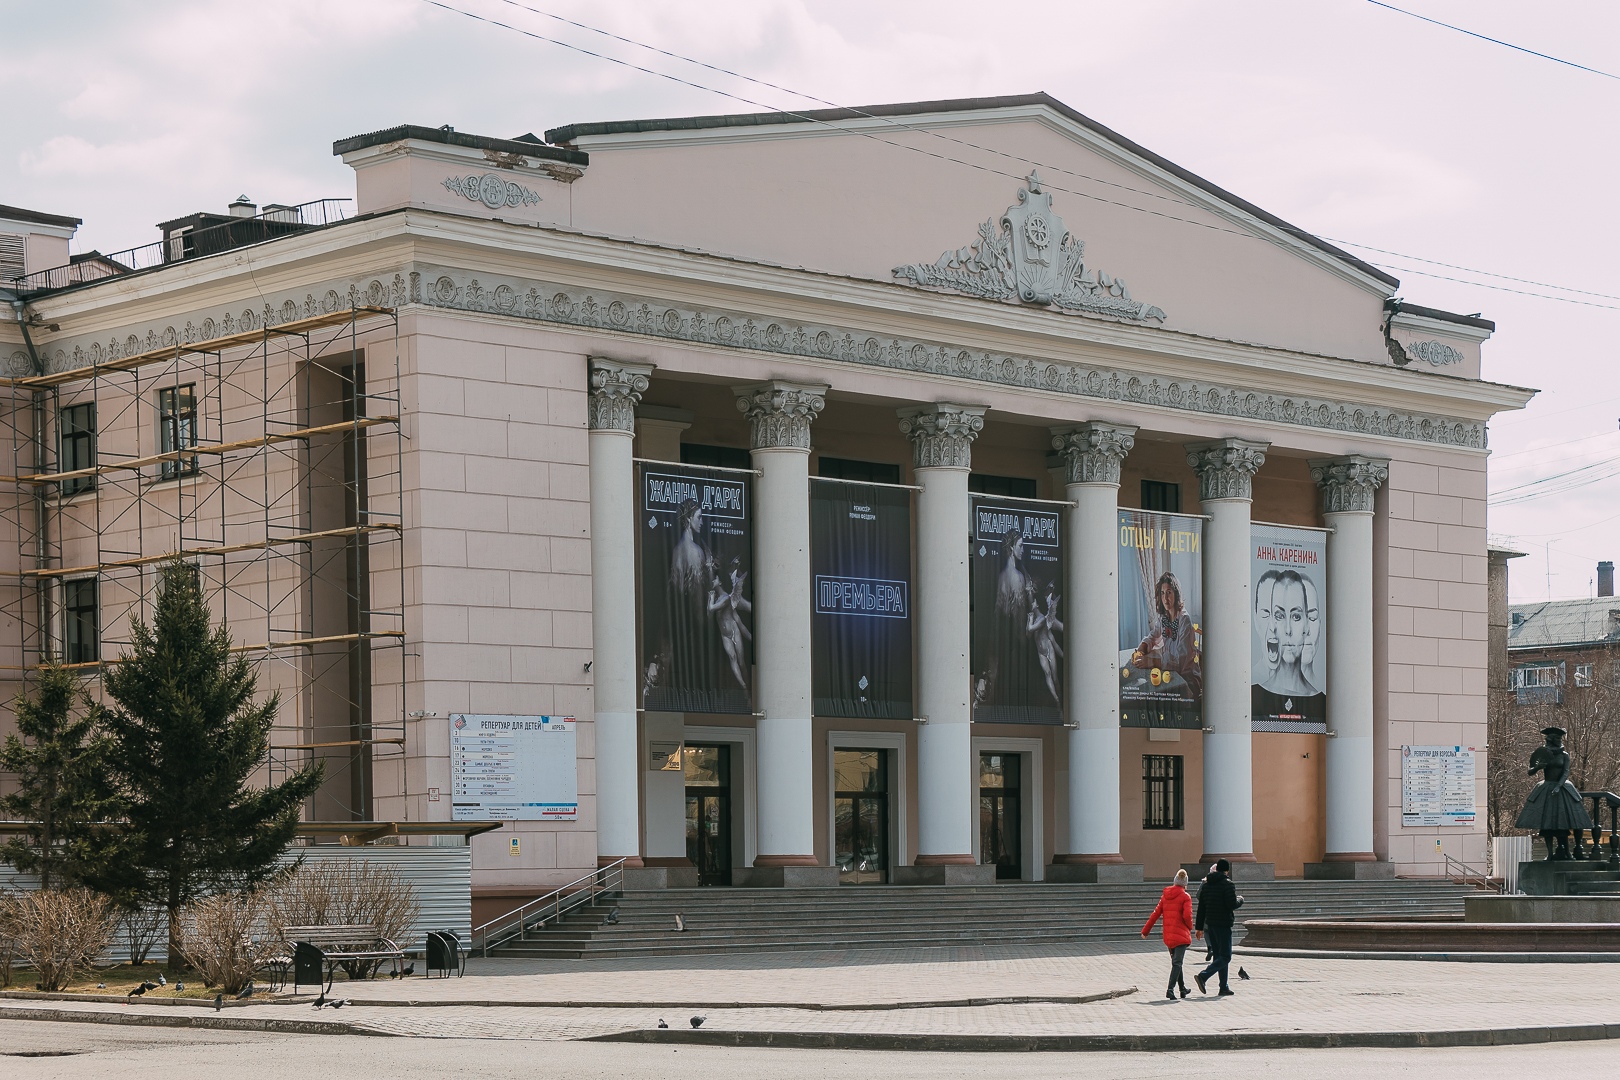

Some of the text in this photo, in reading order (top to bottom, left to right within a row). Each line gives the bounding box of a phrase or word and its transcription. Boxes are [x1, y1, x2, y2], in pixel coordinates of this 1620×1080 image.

[650, 480, 740, 510] ЖАННА Д'АРК
[980, 511, 1055, 539] ЖАННА Д'АРК
[1121, 525, 1199, 554] ОТЦЫ И ДЕТИ
[1257, 546, 1318, 565] АННА КАРЕНИНА
[820, 580, 904, 613] ПРЕМЬЕРА
[481, 720, 542, 731] РЕПЕРТУАР ДЛЯ ДЕТЕЙ
